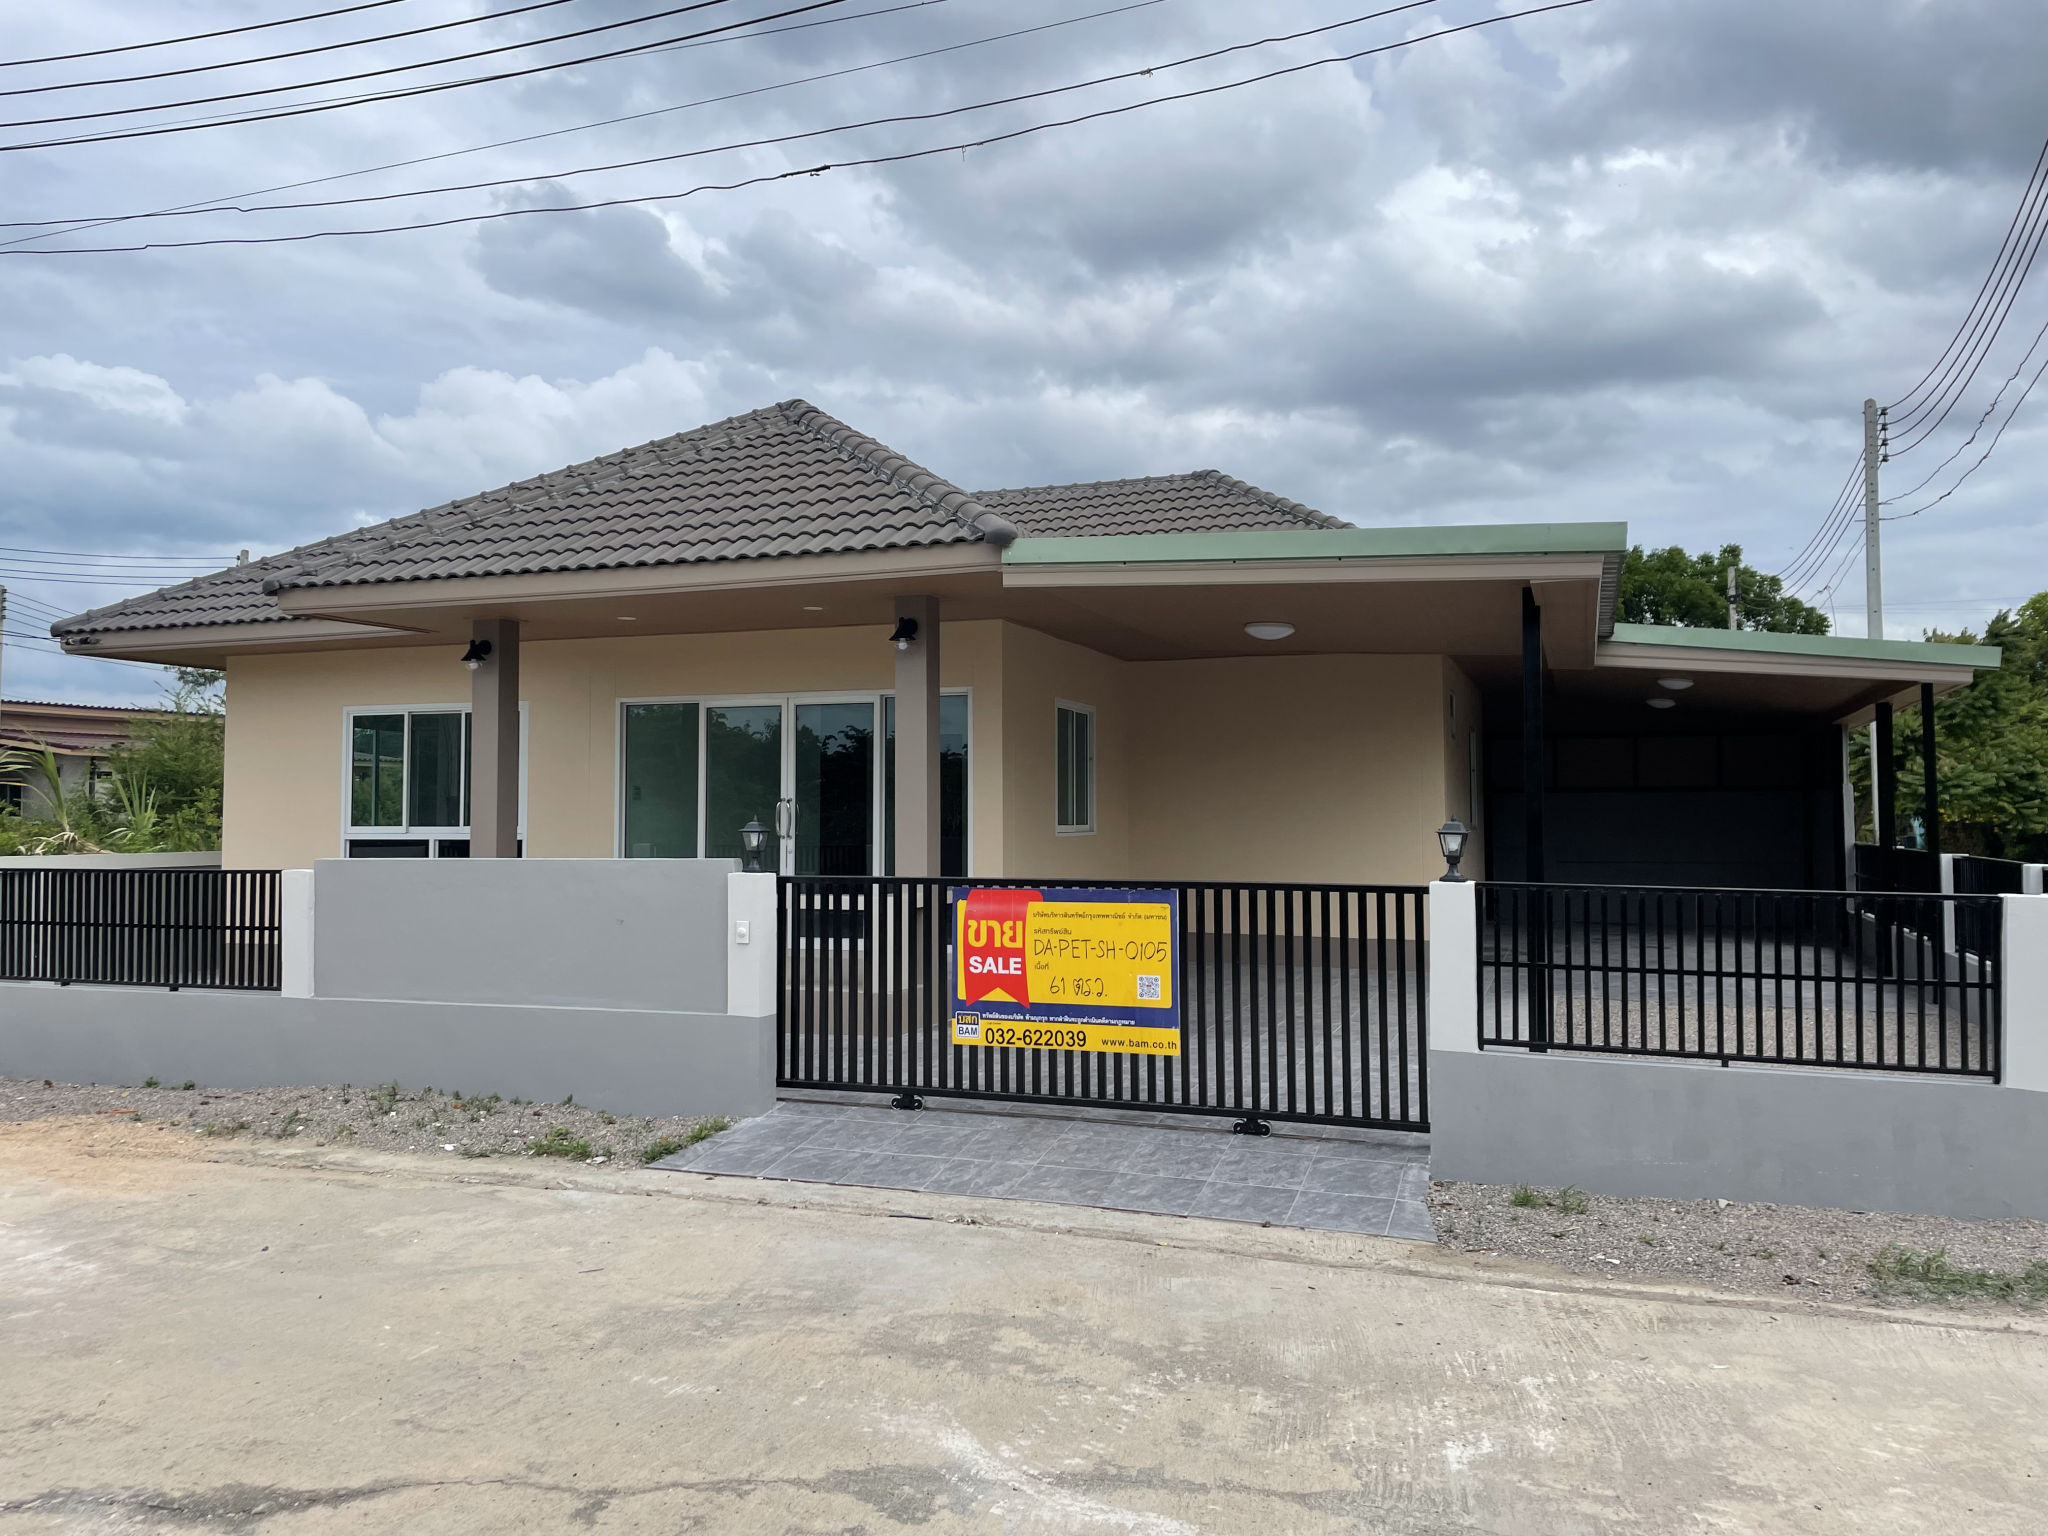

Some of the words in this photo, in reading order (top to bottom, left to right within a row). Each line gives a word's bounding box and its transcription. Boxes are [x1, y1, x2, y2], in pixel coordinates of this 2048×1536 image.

[968, 919, 1023, 948] ขาย
[1034, 939, 1168, 962] DA-PET-SH-0105
[969, 956, 1022, 975] SALE
[1050, 976, 1066, 995] 61
[958, 1014, 978, 1024] บสก
[958, 1026, 978, 1036] BAM
[985, 1027, 1087, 1047] 032-622039
[1101, 1038, 1177, 1050] www.bam.co.th
